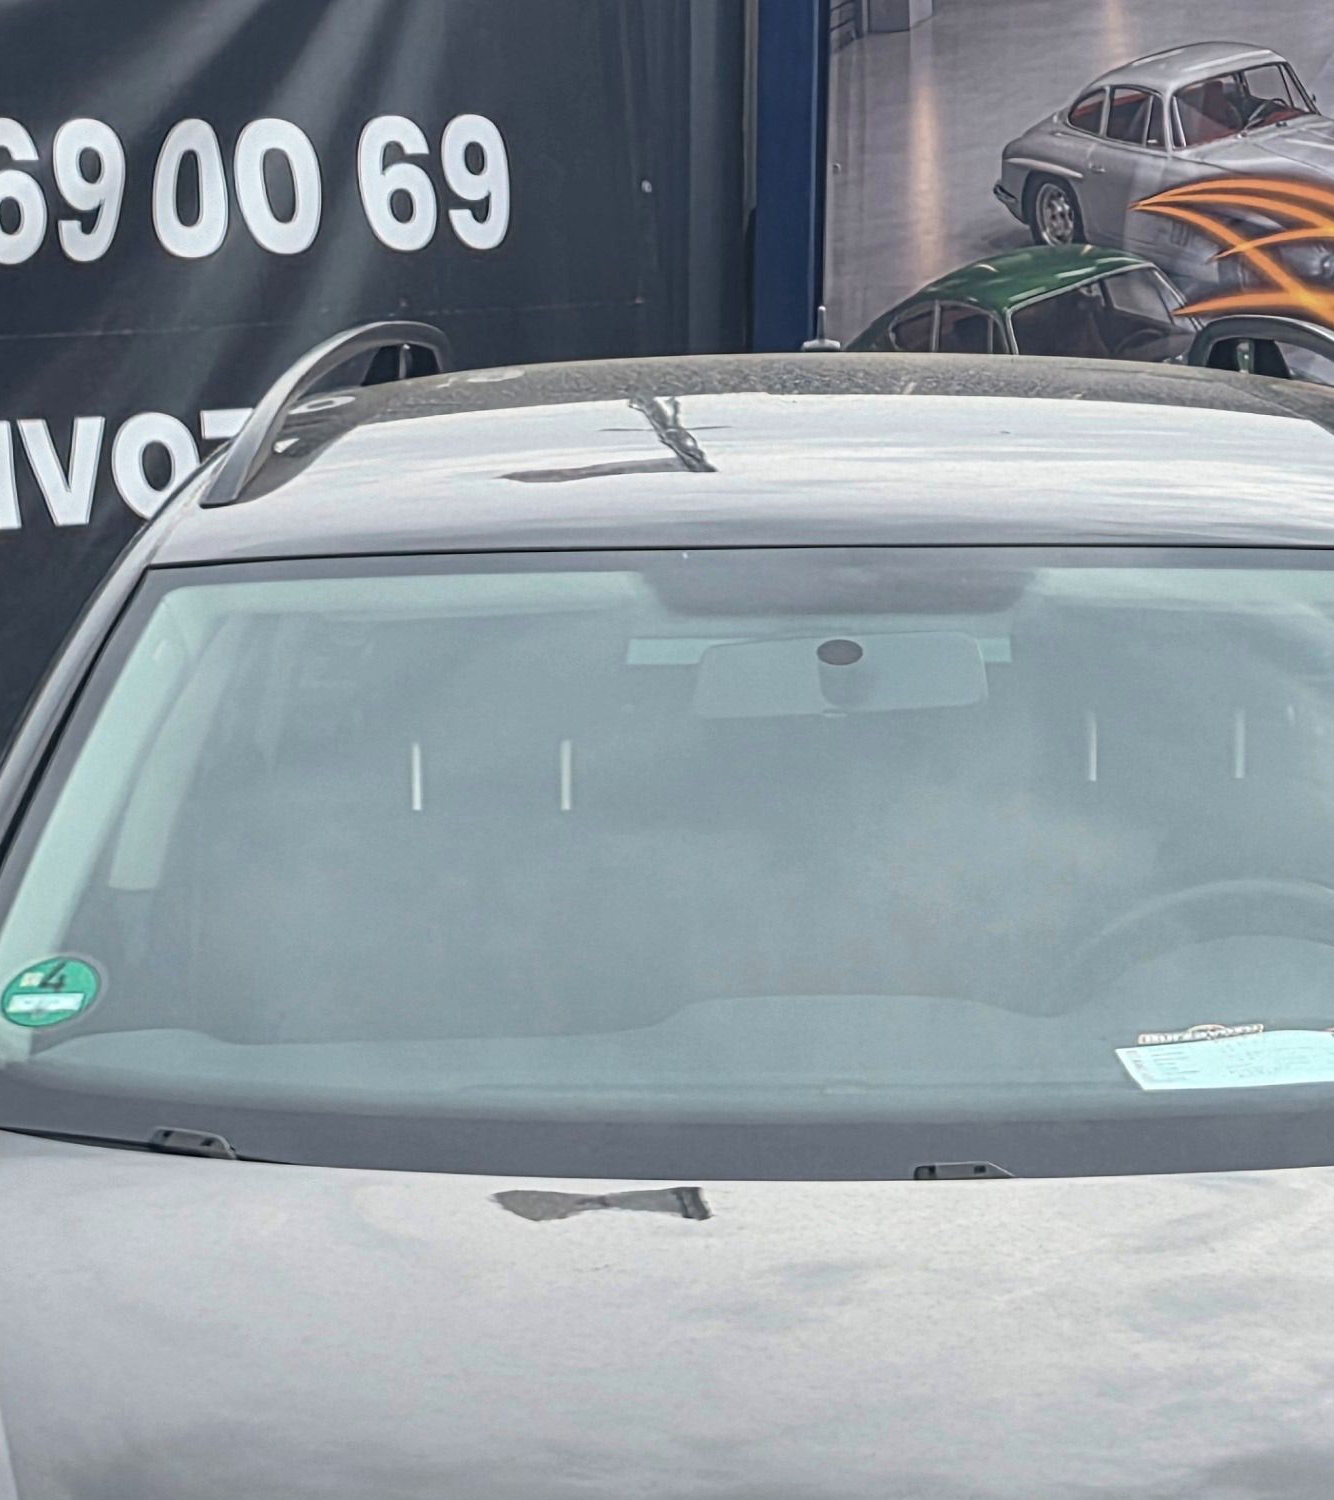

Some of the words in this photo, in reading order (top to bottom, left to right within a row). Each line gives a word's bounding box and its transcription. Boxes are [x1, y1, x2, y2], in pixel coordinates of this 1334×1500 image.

[152, 117, 322, 259] 00
[357, 113, 510, 251] 69
[38, 960, 66, 993] 4
